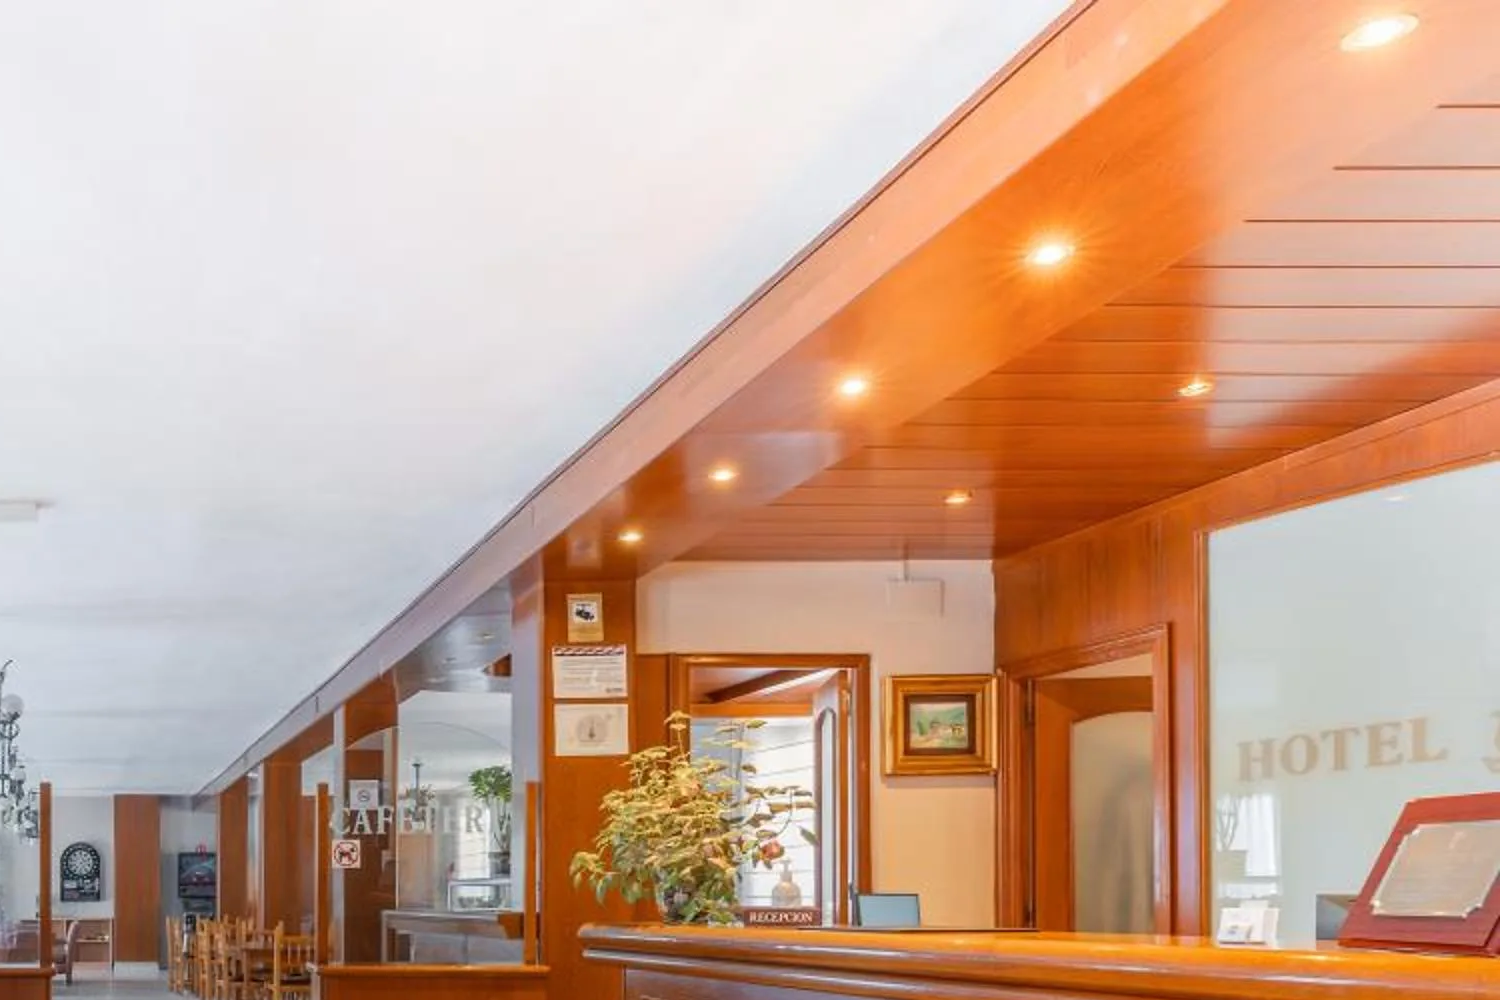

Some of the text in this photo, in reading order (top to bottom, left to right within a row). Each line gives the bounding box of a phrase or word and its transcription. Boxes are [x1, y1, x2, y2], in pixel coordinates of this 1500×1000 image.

[1237, 716, 1449, 783] HOTEL
[330, 805, 516, 835] CAFETER
[749, 911, 814, 923] RECEPCION
